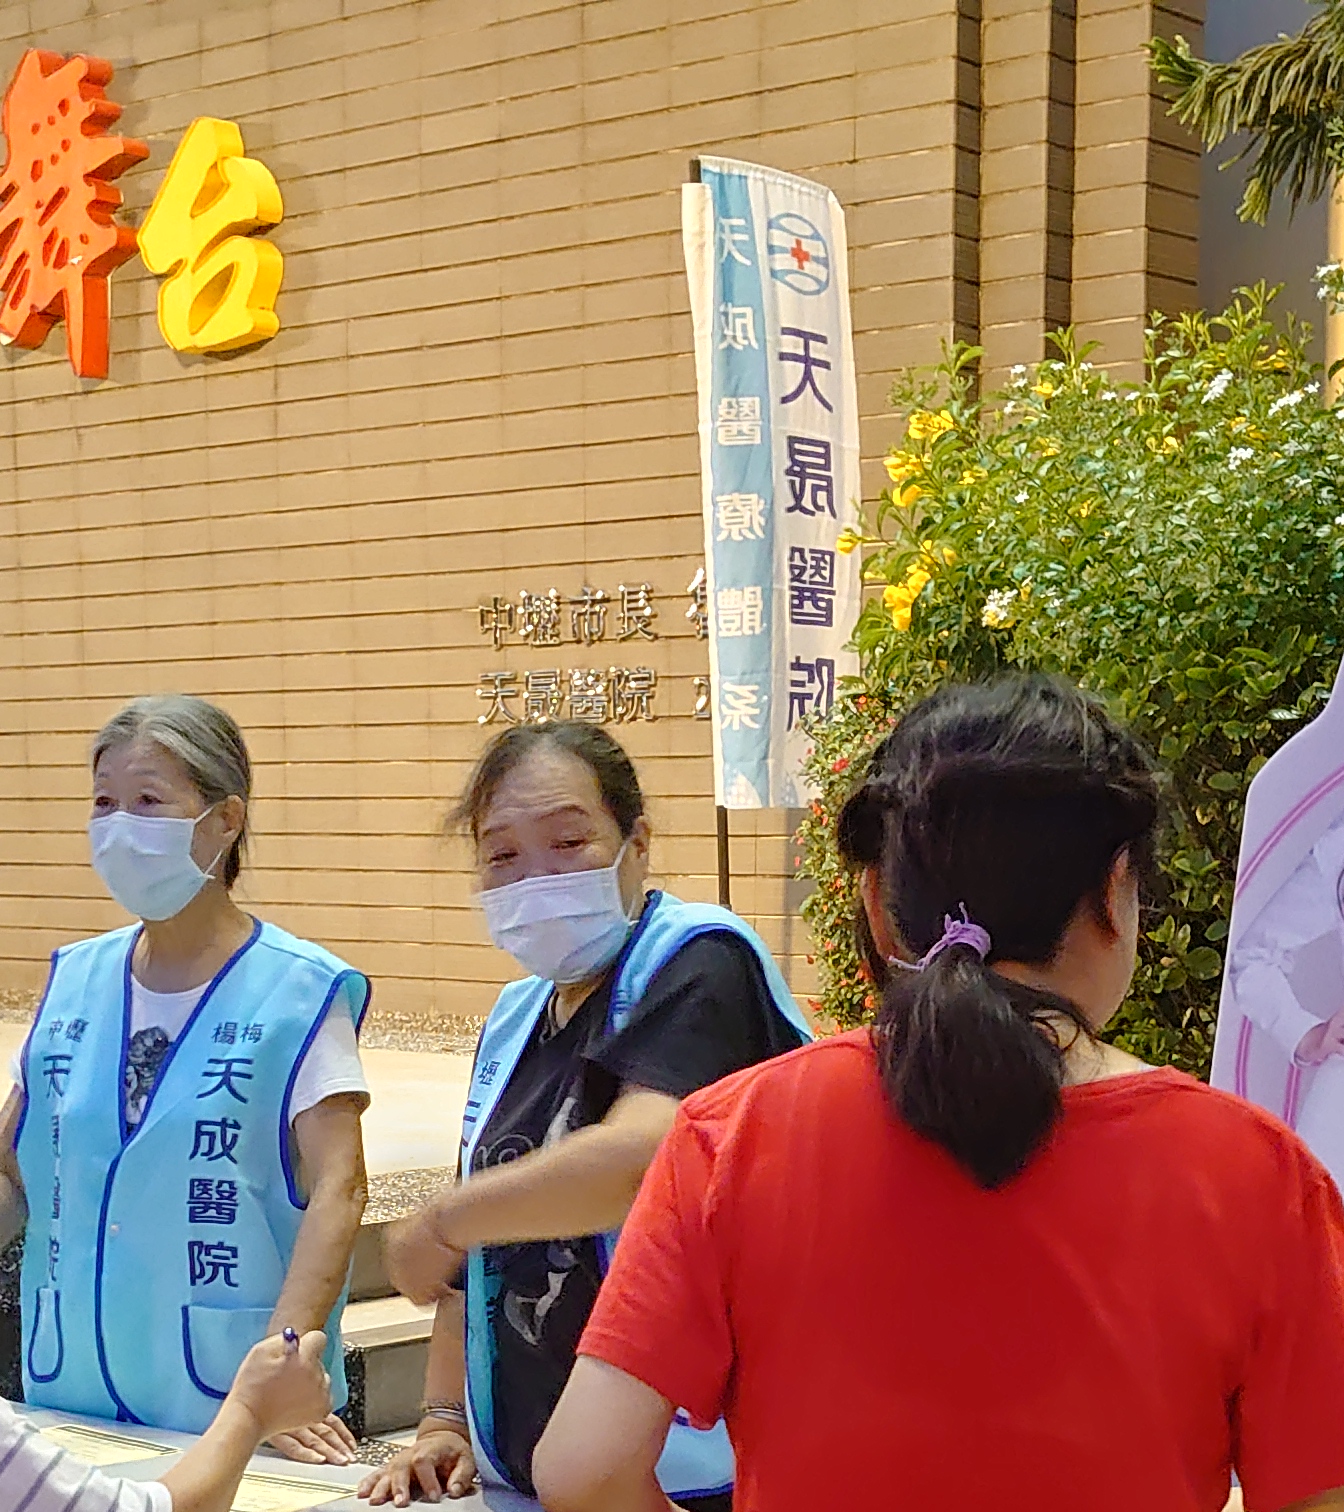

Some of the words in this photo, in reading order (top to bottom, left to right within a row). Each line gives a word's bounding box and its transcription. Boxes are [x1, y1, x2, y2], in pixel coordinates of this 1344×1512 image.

[478, 582, 657, 650] 中壢市長
[475, 665, 658, 726] 天晟醫院
[210, 1021, 263, 1045] 楊梅
[185, 1056, 254, 1289] 天成醫院
